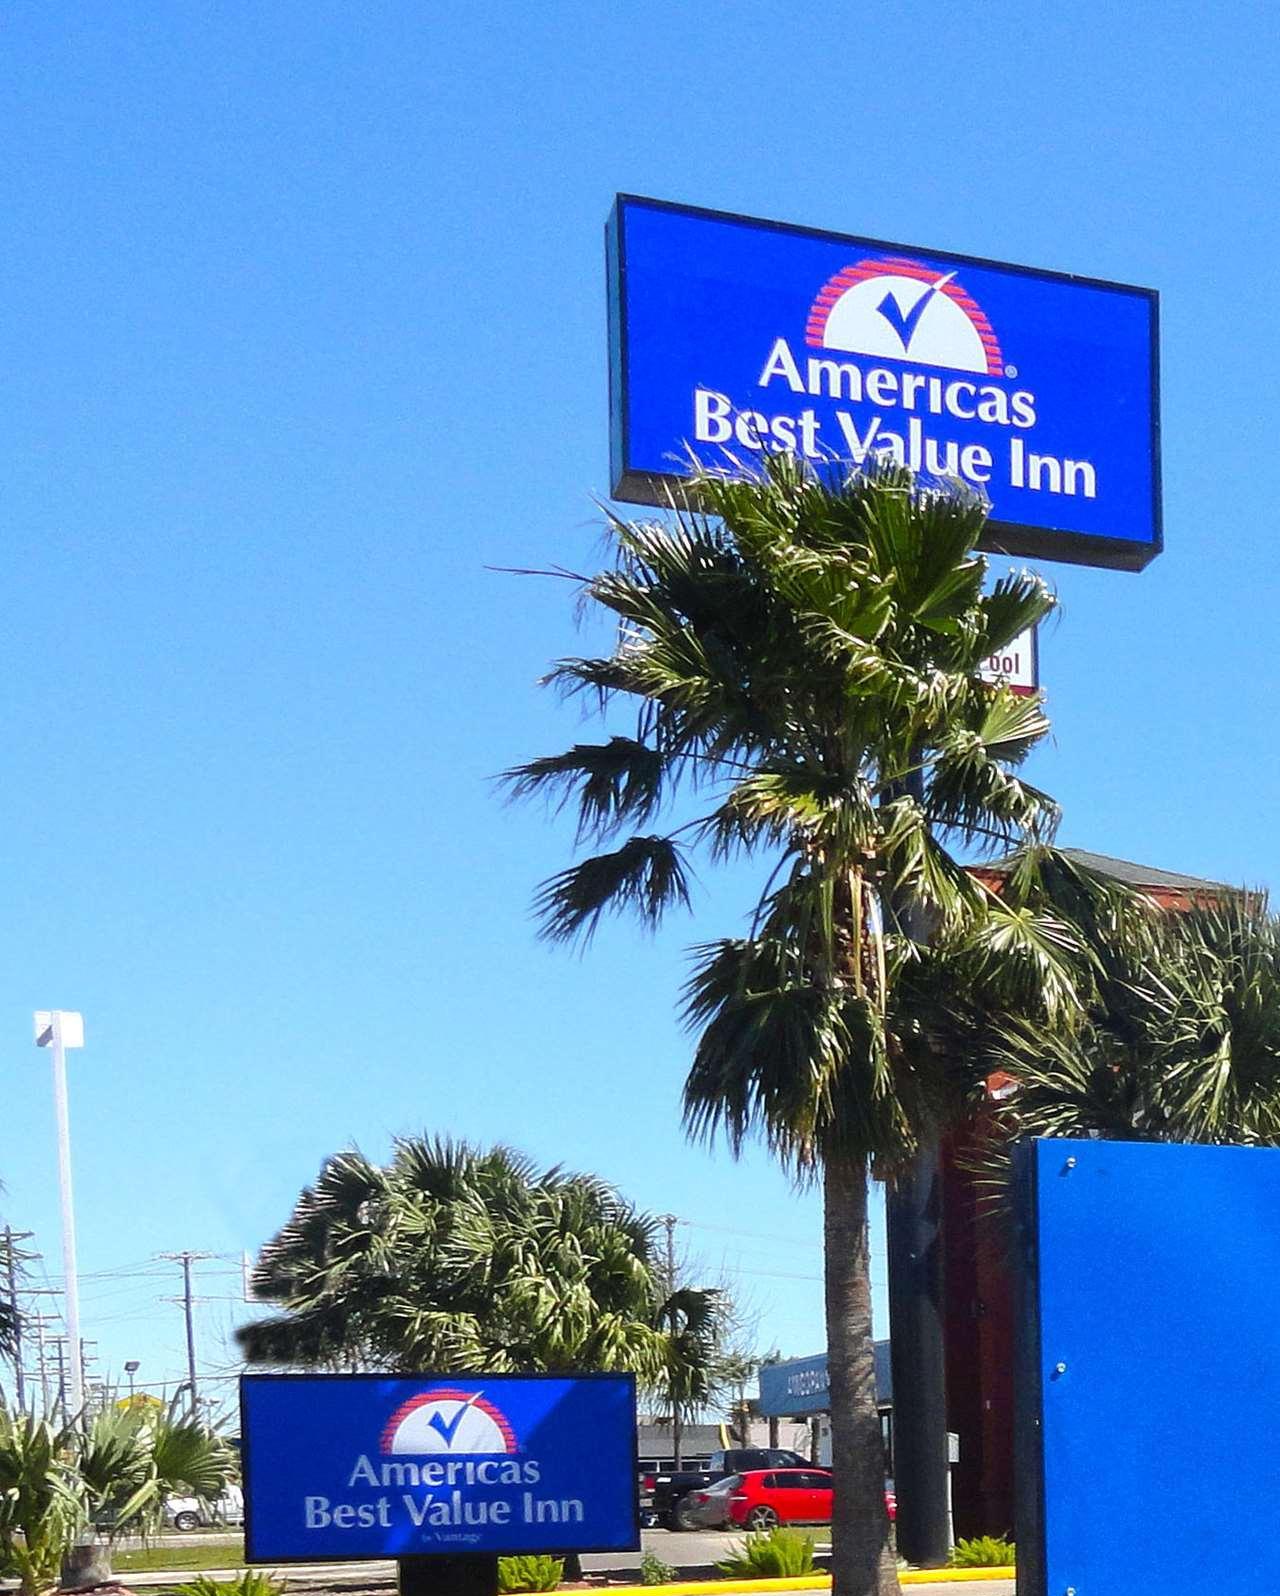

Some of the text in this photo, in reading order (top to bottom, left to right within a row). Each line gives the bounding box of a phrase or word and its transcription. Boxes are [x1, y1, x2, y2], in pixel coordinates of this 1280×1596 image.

[758, 338, 1036, 428] Americas
[695, 388, 1097, 499] Best Value Inn
[348, 1454, 540, 1487] Americas
[305, 1490, 584, 1529] Best Value Inn
